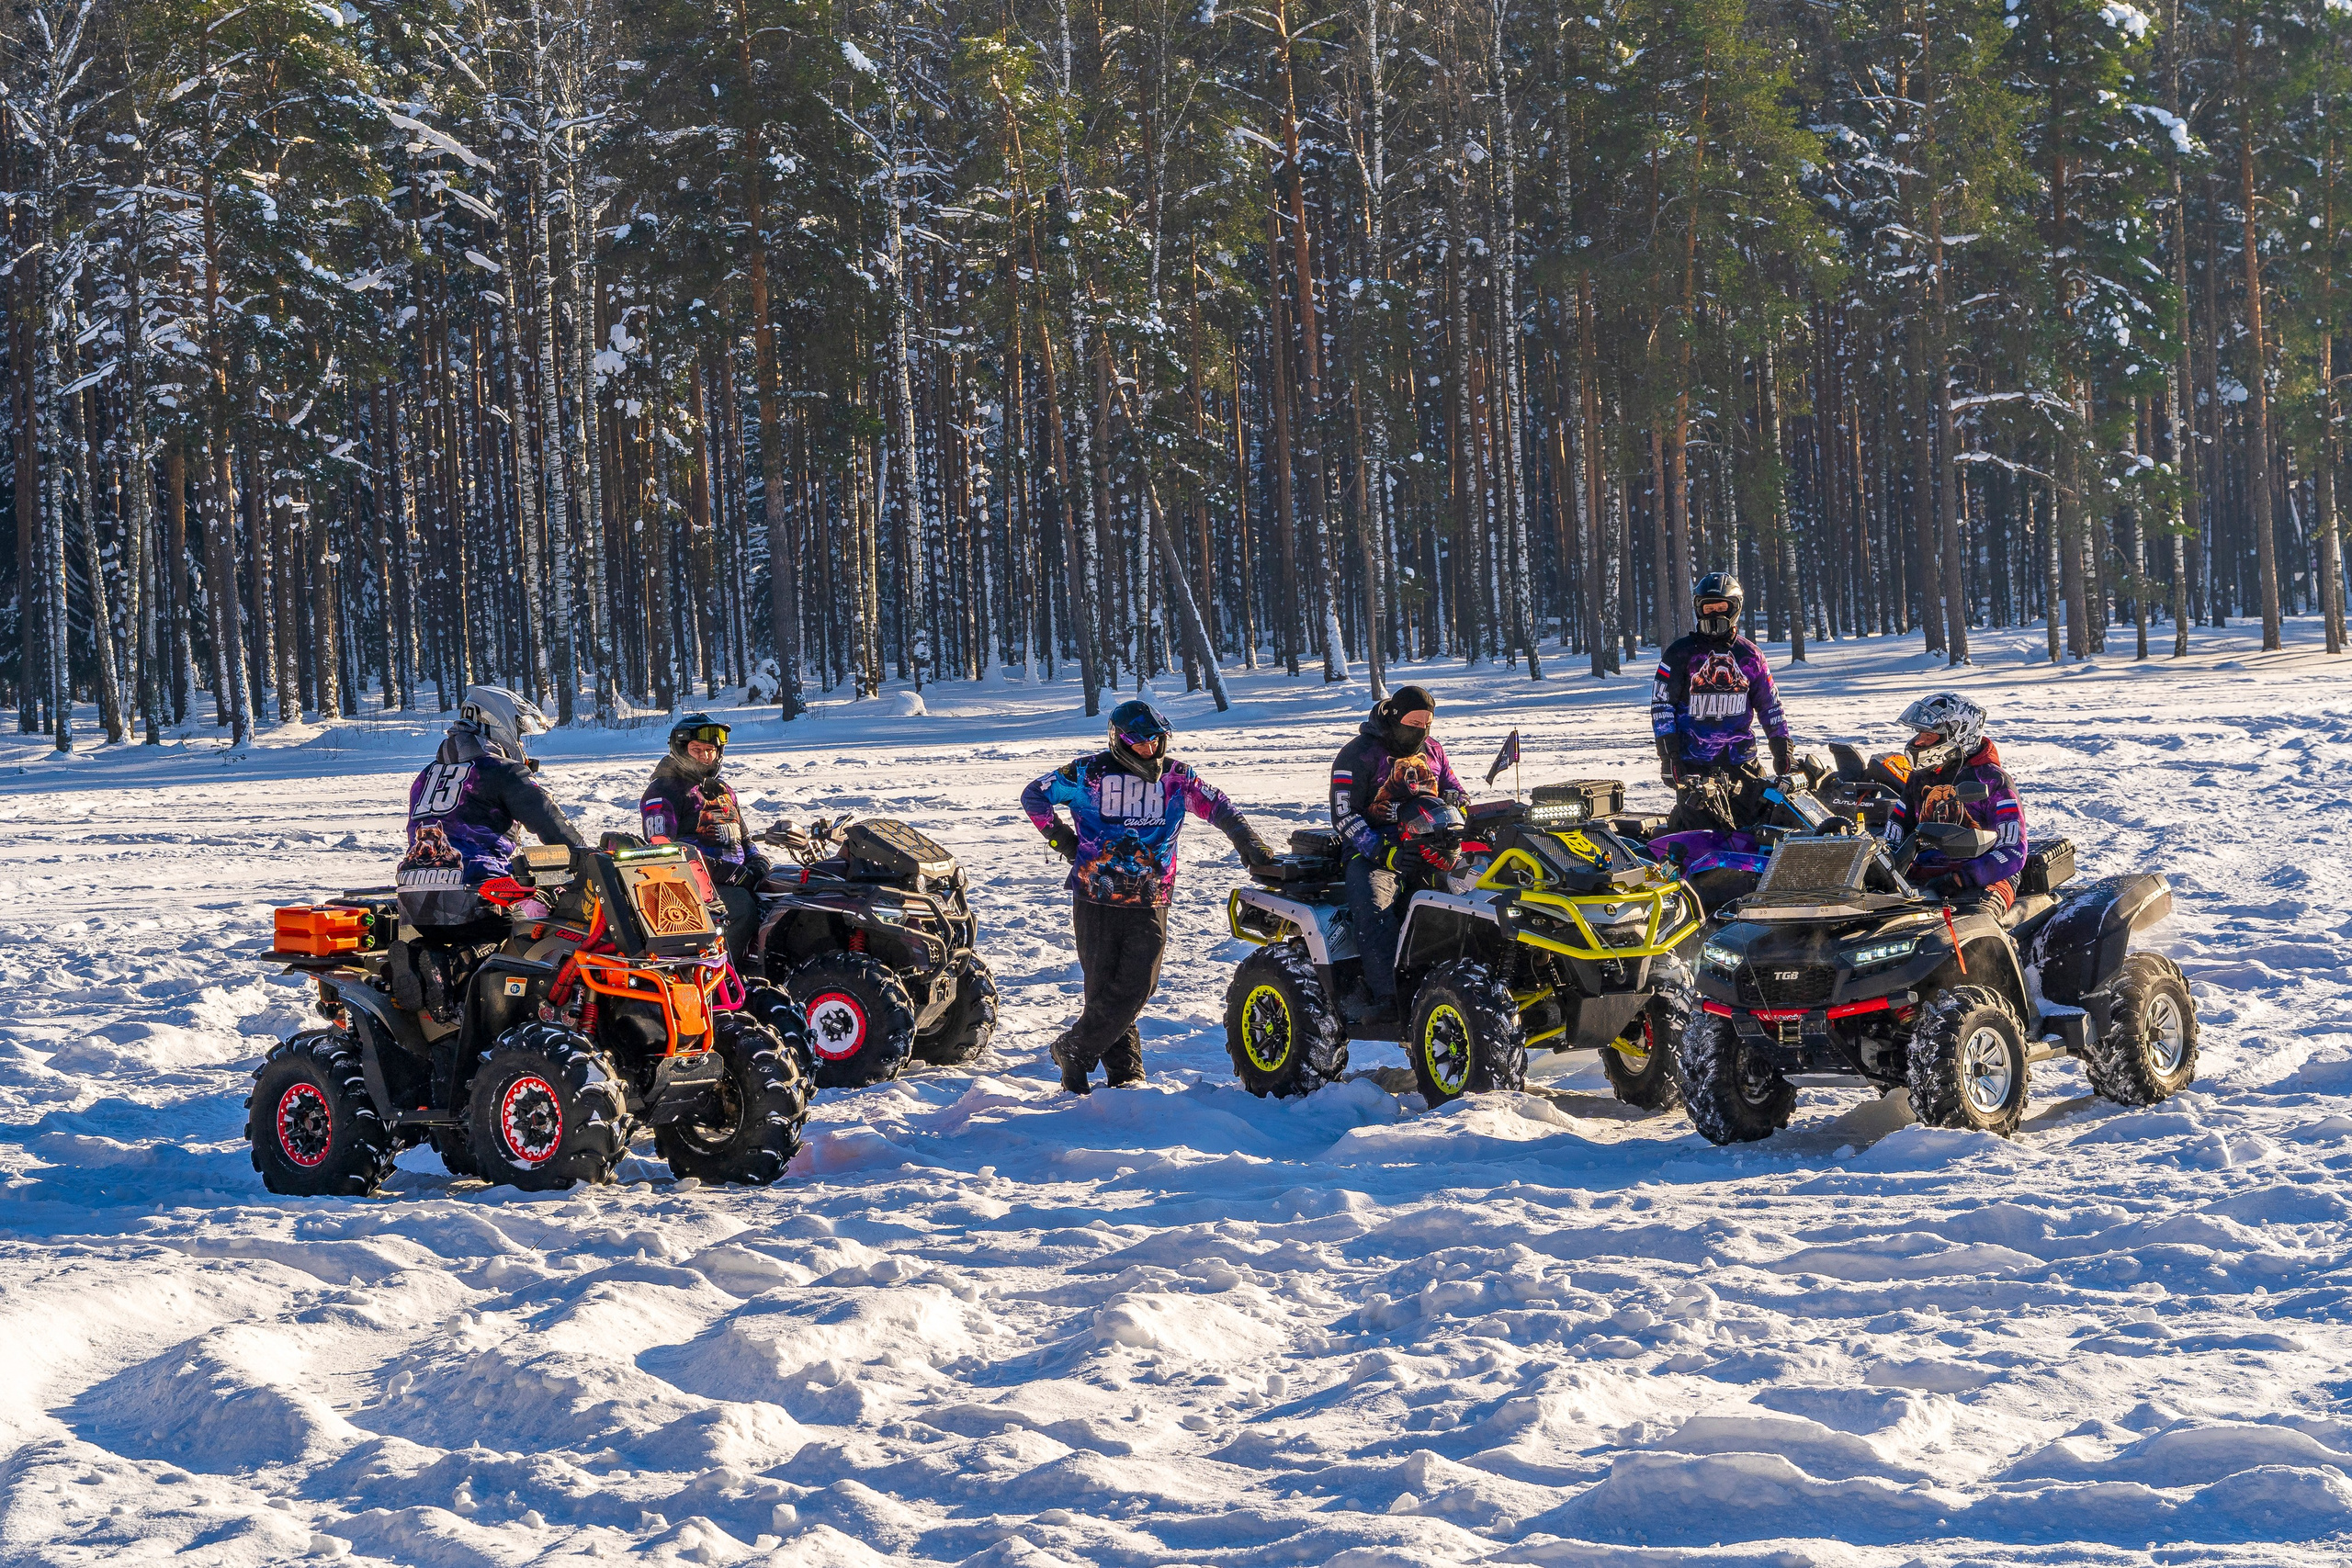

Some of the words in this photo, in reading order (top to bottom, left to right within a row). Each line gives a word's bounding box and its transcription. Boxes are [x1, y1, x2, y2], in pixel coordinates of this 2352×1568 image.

[1652, 680, 1668, 702] 14
[413, 761, 475, 818] 13
[1101, 774, 1165, 818] GRB
[1335, 790, 1351, 818] 5
[1832, 798, 1874, 807] OUTLADER
[645, 814, 666, 840] 88
[1124, 812, 1167, 827] custom
[1996, 819, 2020, 849] 10
[529, 851, 568, 862] can-am
[555, 929, 584, 942] can-
[1774, 971, 1800, 981] TGB
